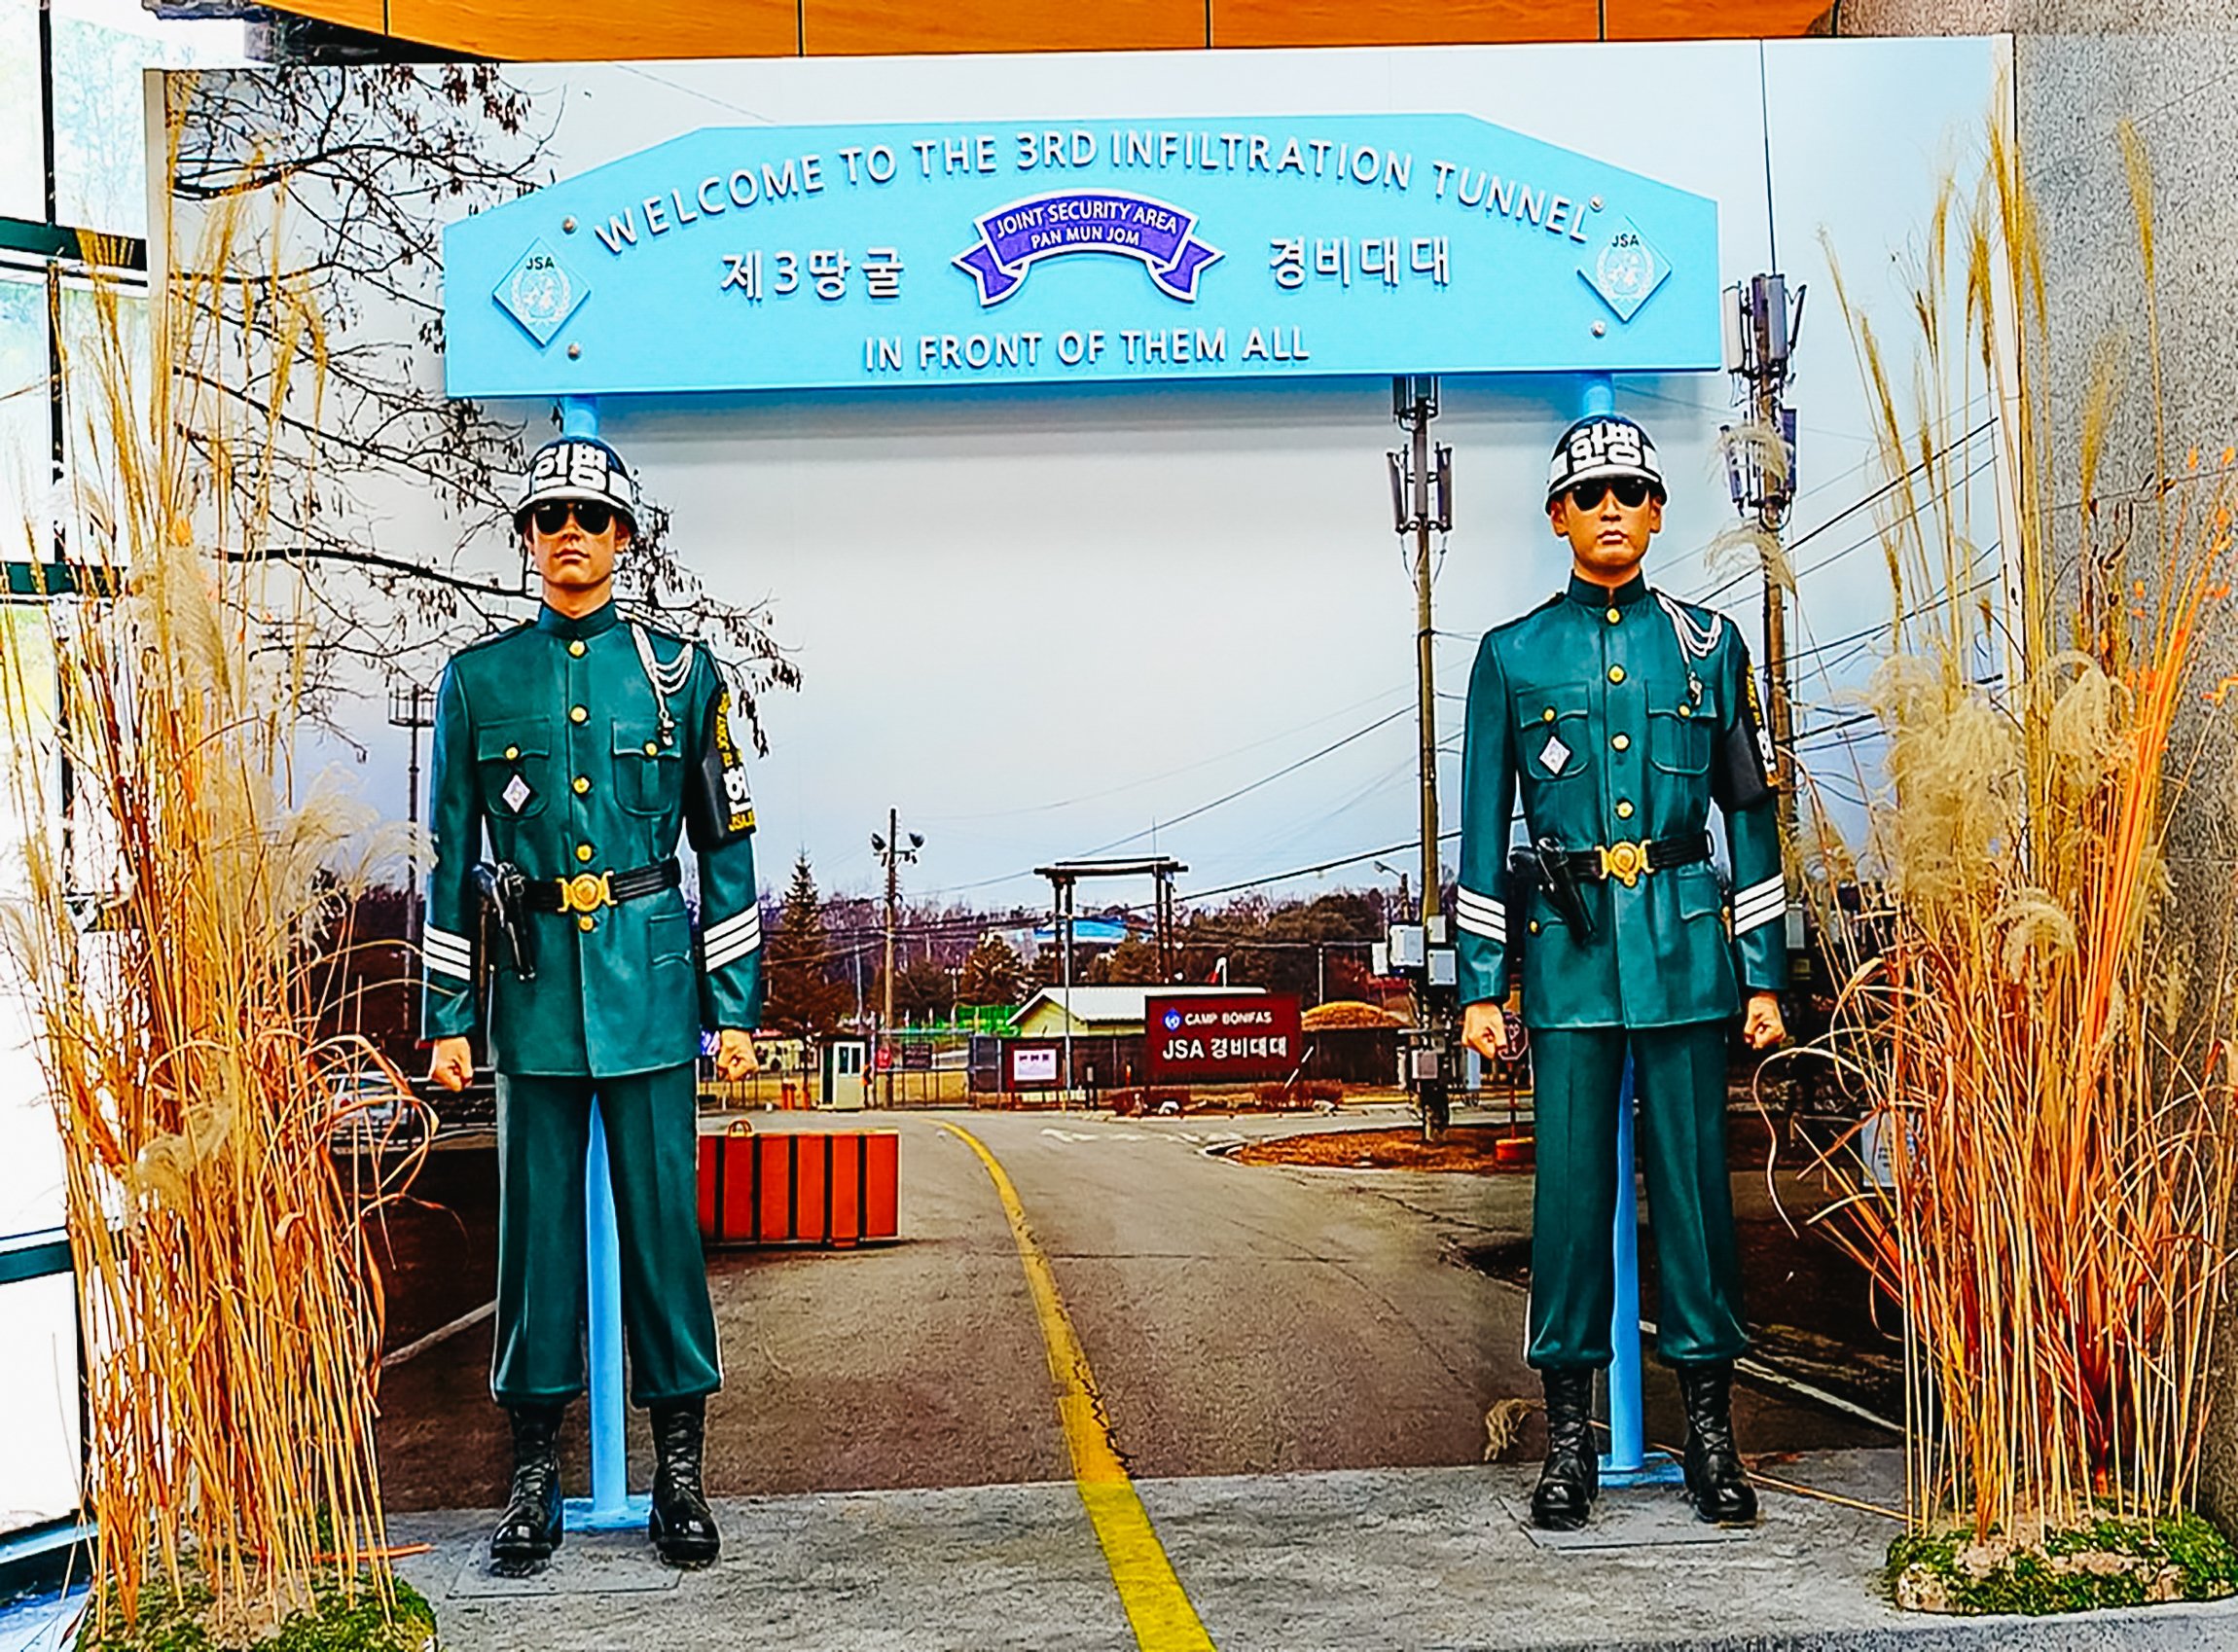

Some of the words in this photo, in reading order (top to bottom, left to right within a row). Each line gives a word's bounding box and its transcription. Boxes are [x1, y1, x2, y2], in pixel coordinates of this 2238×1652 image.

[594, 154, 825, 252] WELCOME
[840, 145, 896, 183] TO
[913, 134, 997, 176] THE
[1017, 128, 1097, 169] 3RD
[1112, 128, 1413, 190] INFILTRATION
[1433, 159, 1590, 243] TUNNEL
[995, 206, 1044, 238] JOINT
[1048, 199, 1129, 224] SECURITY
[1133, 206, 1178, 234] AREA
[1029, 229, 1063, 250] PAN
[1065, 226, 1103, 242] MUN
[1106, 228, 1141, 247] JOM
[1611, 233, 1640, 248] JSA
[525, 256, 556, 270] JSA
[721, 248, 905, 301] 제3땅굴
[1269, 235, 1451, 288] 경비대대
[865, 337, 902, 370] IN
[920, 332, 1043, 368] FRONT
[1058, 330, 1106, 364] OF
[1120, 328, 1226, 362] THEM
[1243, 327, 1310, 360] ALL
[1184, 1012, 1217, 1025] CAMP
[1221, 1011, 1273, 1025] BONIFAS
[1162, 1038, 1205, 1059] JSA
[1210, 1035, 1287, 1059] 경비대대
